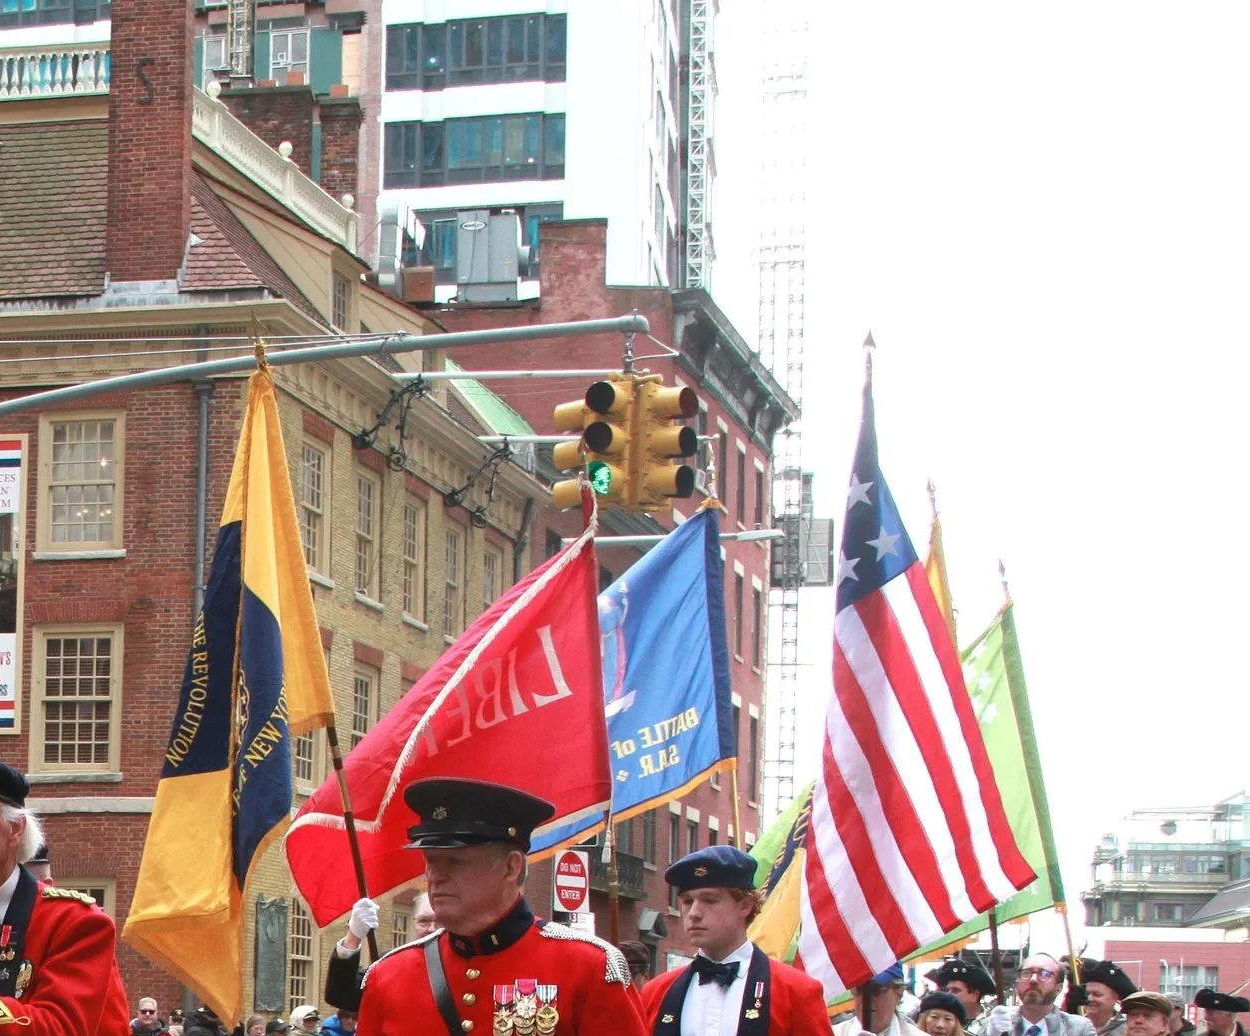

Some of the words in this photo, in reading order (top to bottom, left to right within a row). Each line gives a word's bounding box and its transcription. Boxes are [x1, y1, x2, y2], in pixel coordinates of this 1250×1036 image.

[165, 651, 209, 767] REVOLUTION
[244, 720, 283, 769] NEW
[560, 862, 568, 872] DO
[570, 863, 582, 873] NOT
[561, 890, 580, 900] ENTER
